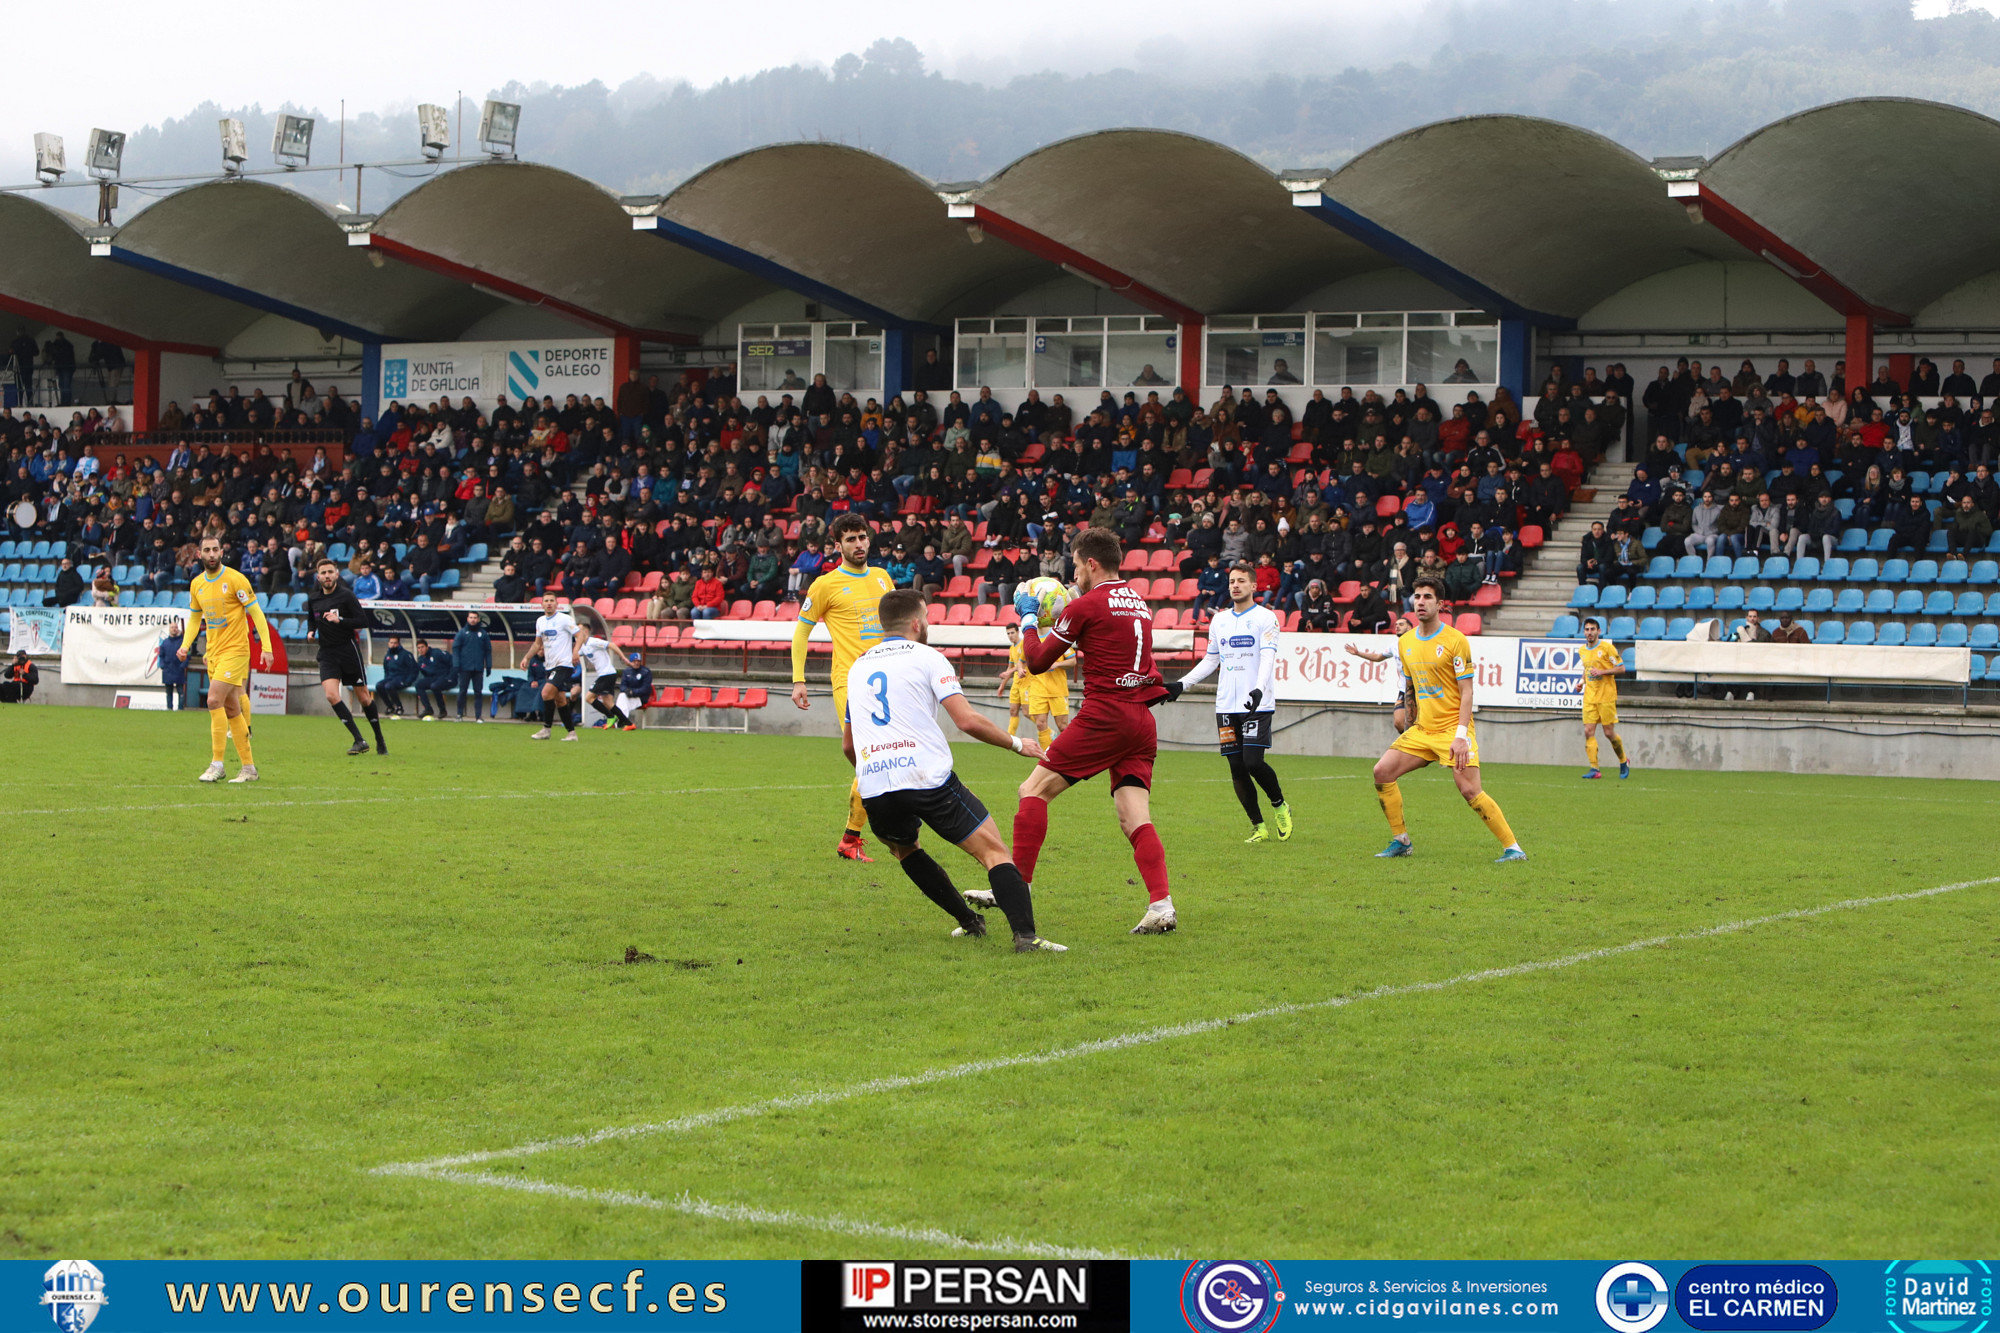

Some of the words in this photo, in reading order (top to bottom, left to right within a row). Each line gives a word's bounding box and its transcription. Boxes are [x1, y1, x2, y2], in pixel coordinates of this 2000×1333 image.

[545, 348, 608, 362] DEPORTE
[412, 361, 454, 376] XUNTA
[545, 363, 600, 377] GALEGO
[411, 378, 427, 392] DE
[430, 377, 480, 391] GALICIA
[1133, 618, 1143, 672] 1
[1295, 645, 1350, 689] Voz
[1358, 649, 1389, 684] de
[866, 670, 892, 727] 3
[1517, 696, 1555, 706] OURENSE
[1222, 714, 1230, 727] 15
[870, 739, 916, 753] Levagalia
[866, 756, 917, 776] ABANCA
